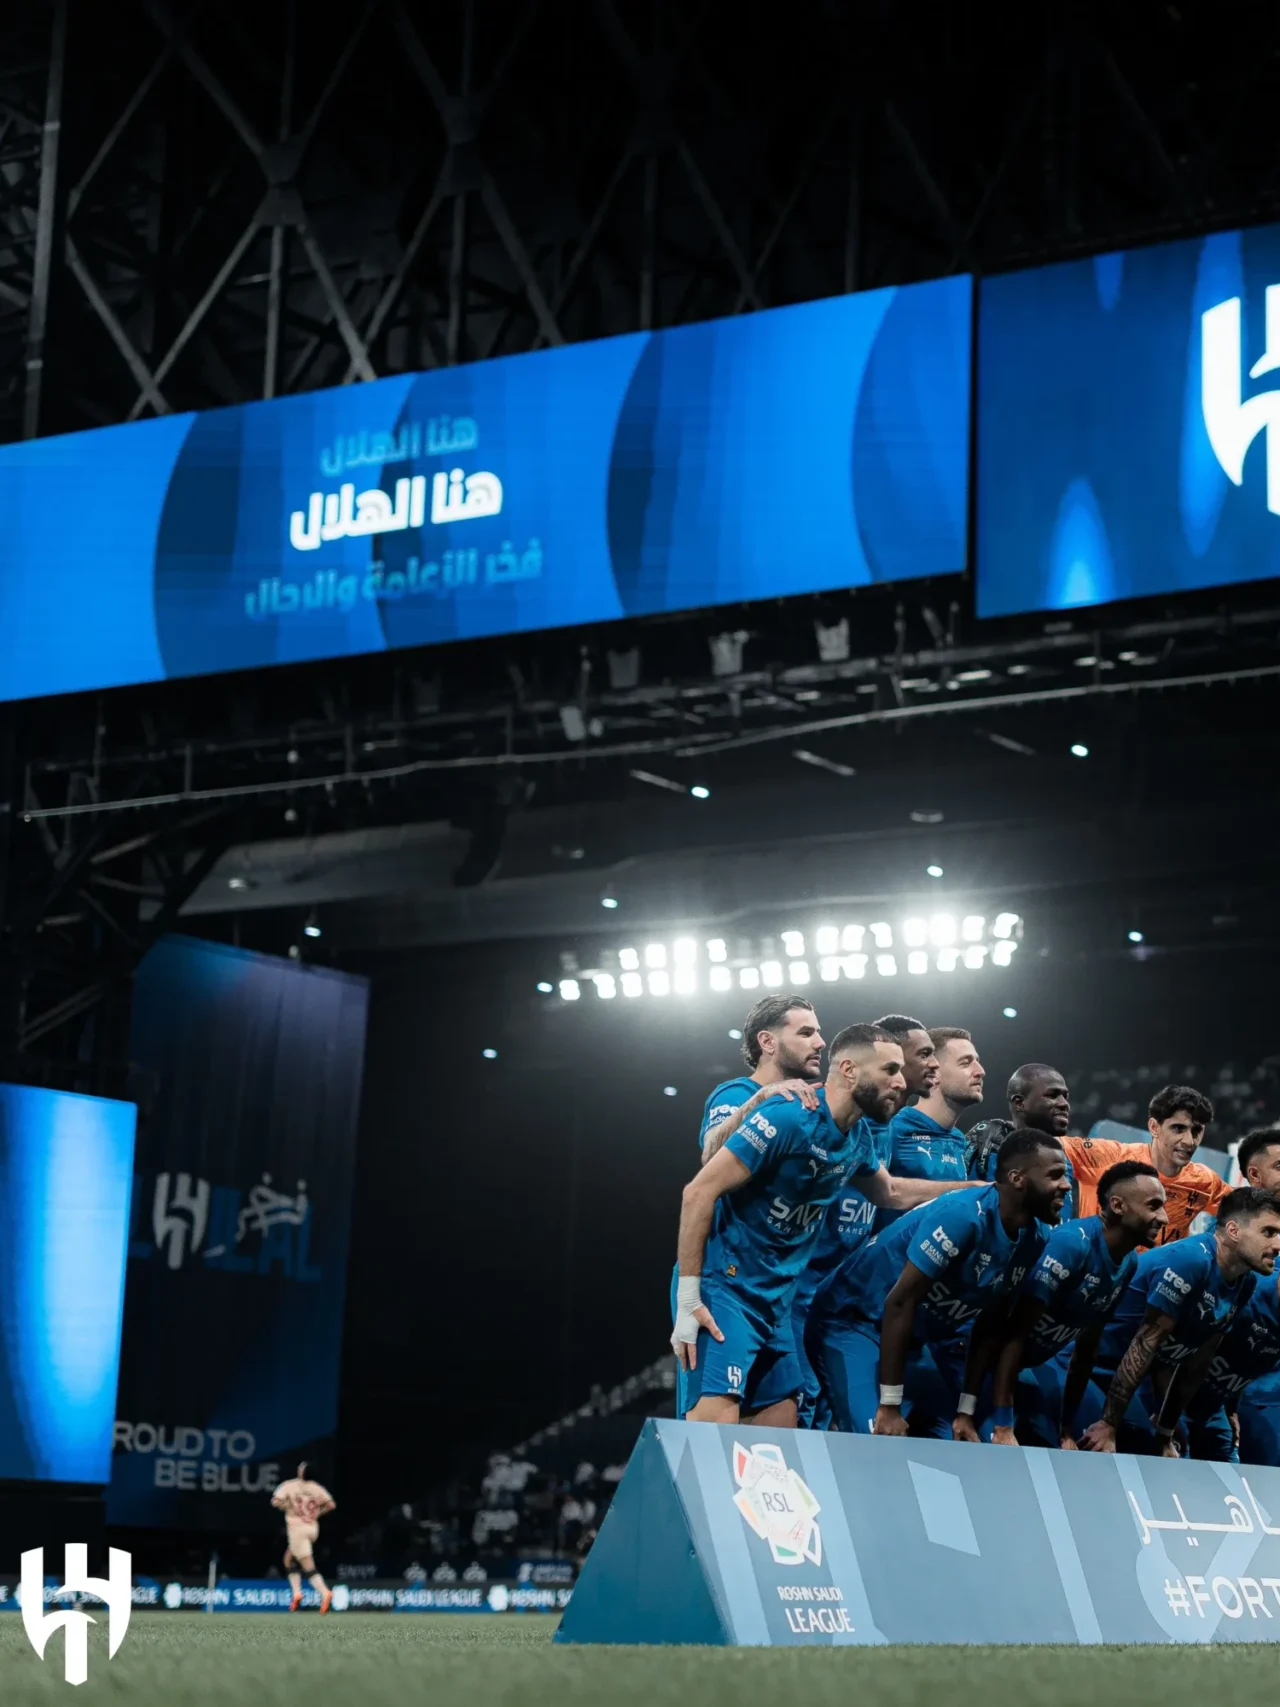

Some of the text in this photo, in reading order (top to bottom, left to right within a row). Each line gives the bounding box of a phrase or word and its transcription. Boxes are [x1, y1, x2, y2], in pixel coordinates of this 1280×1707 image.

[320, 413, 479, 477] هنا الهلال
[290, 467, 503, 551] هنا الهلال
[749, 1111, 778, 1139] tree
[932, 1225, 960, 1257] tree
[1042, 1255, 1070, 1280] tree
[1163, 1266, 1192, 1294] tree
[112, 1421, 256, 1460] ROUD TO
[154, 1458, 280, 1493] BE BLUE
[762, 1491, 795, 1513] RSL
[784, 1607, 856, 1634] LEAGUE
